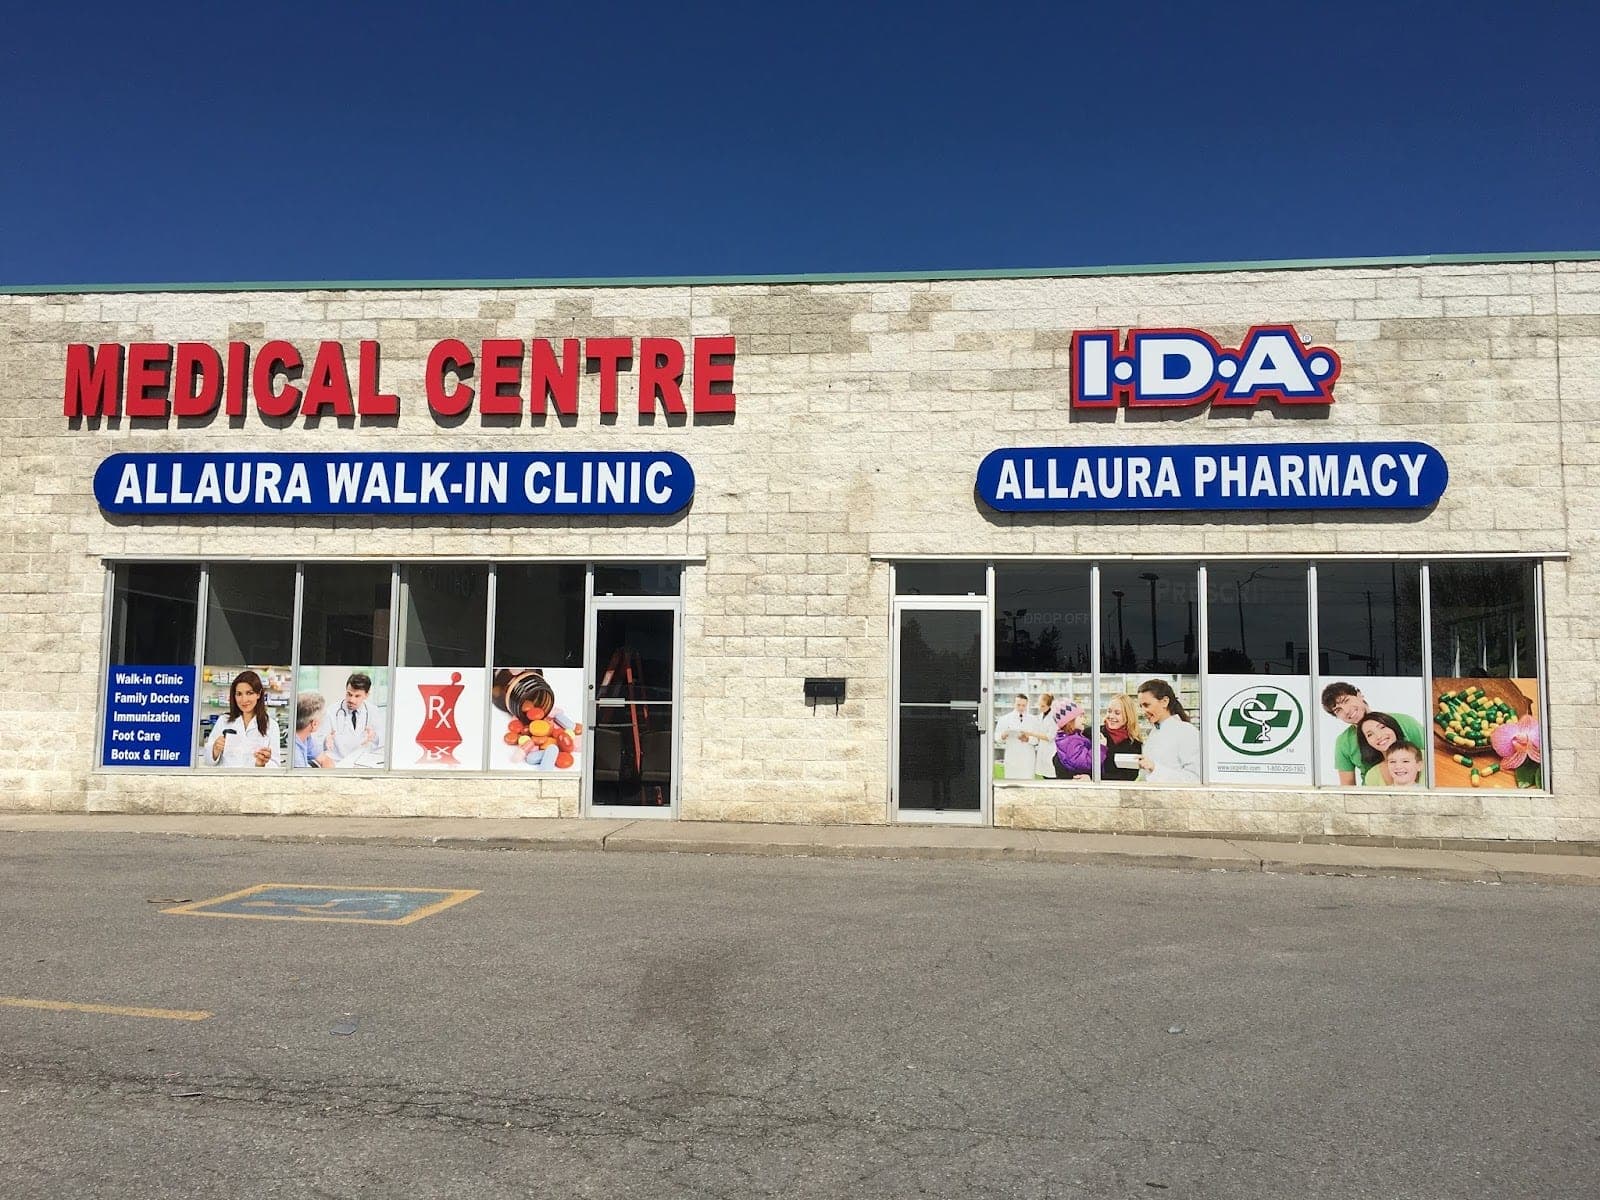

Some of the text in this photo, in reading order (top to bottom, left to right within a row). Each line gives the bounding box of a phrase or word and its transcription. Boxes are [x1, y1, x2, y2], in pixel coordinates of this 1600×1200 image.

[64, 337, 736, 417] MEDICAL CENTRE
[114, 460, 673, 504] ALLAURA WALK-IN CLINIC
[995, 453, 1428, 500] ALLAURA PHARMACY
[1023, 612, 1062, 625] DROP
[115, 673, 183, 685] Walk-in Clinic
[114, 692, 190, 706] Family Doctors
[113, 710, 181, 723] Immunization
[112, 729, 161, 741] Foot Care
[111, 748, 181, 761] Botox & Filler
